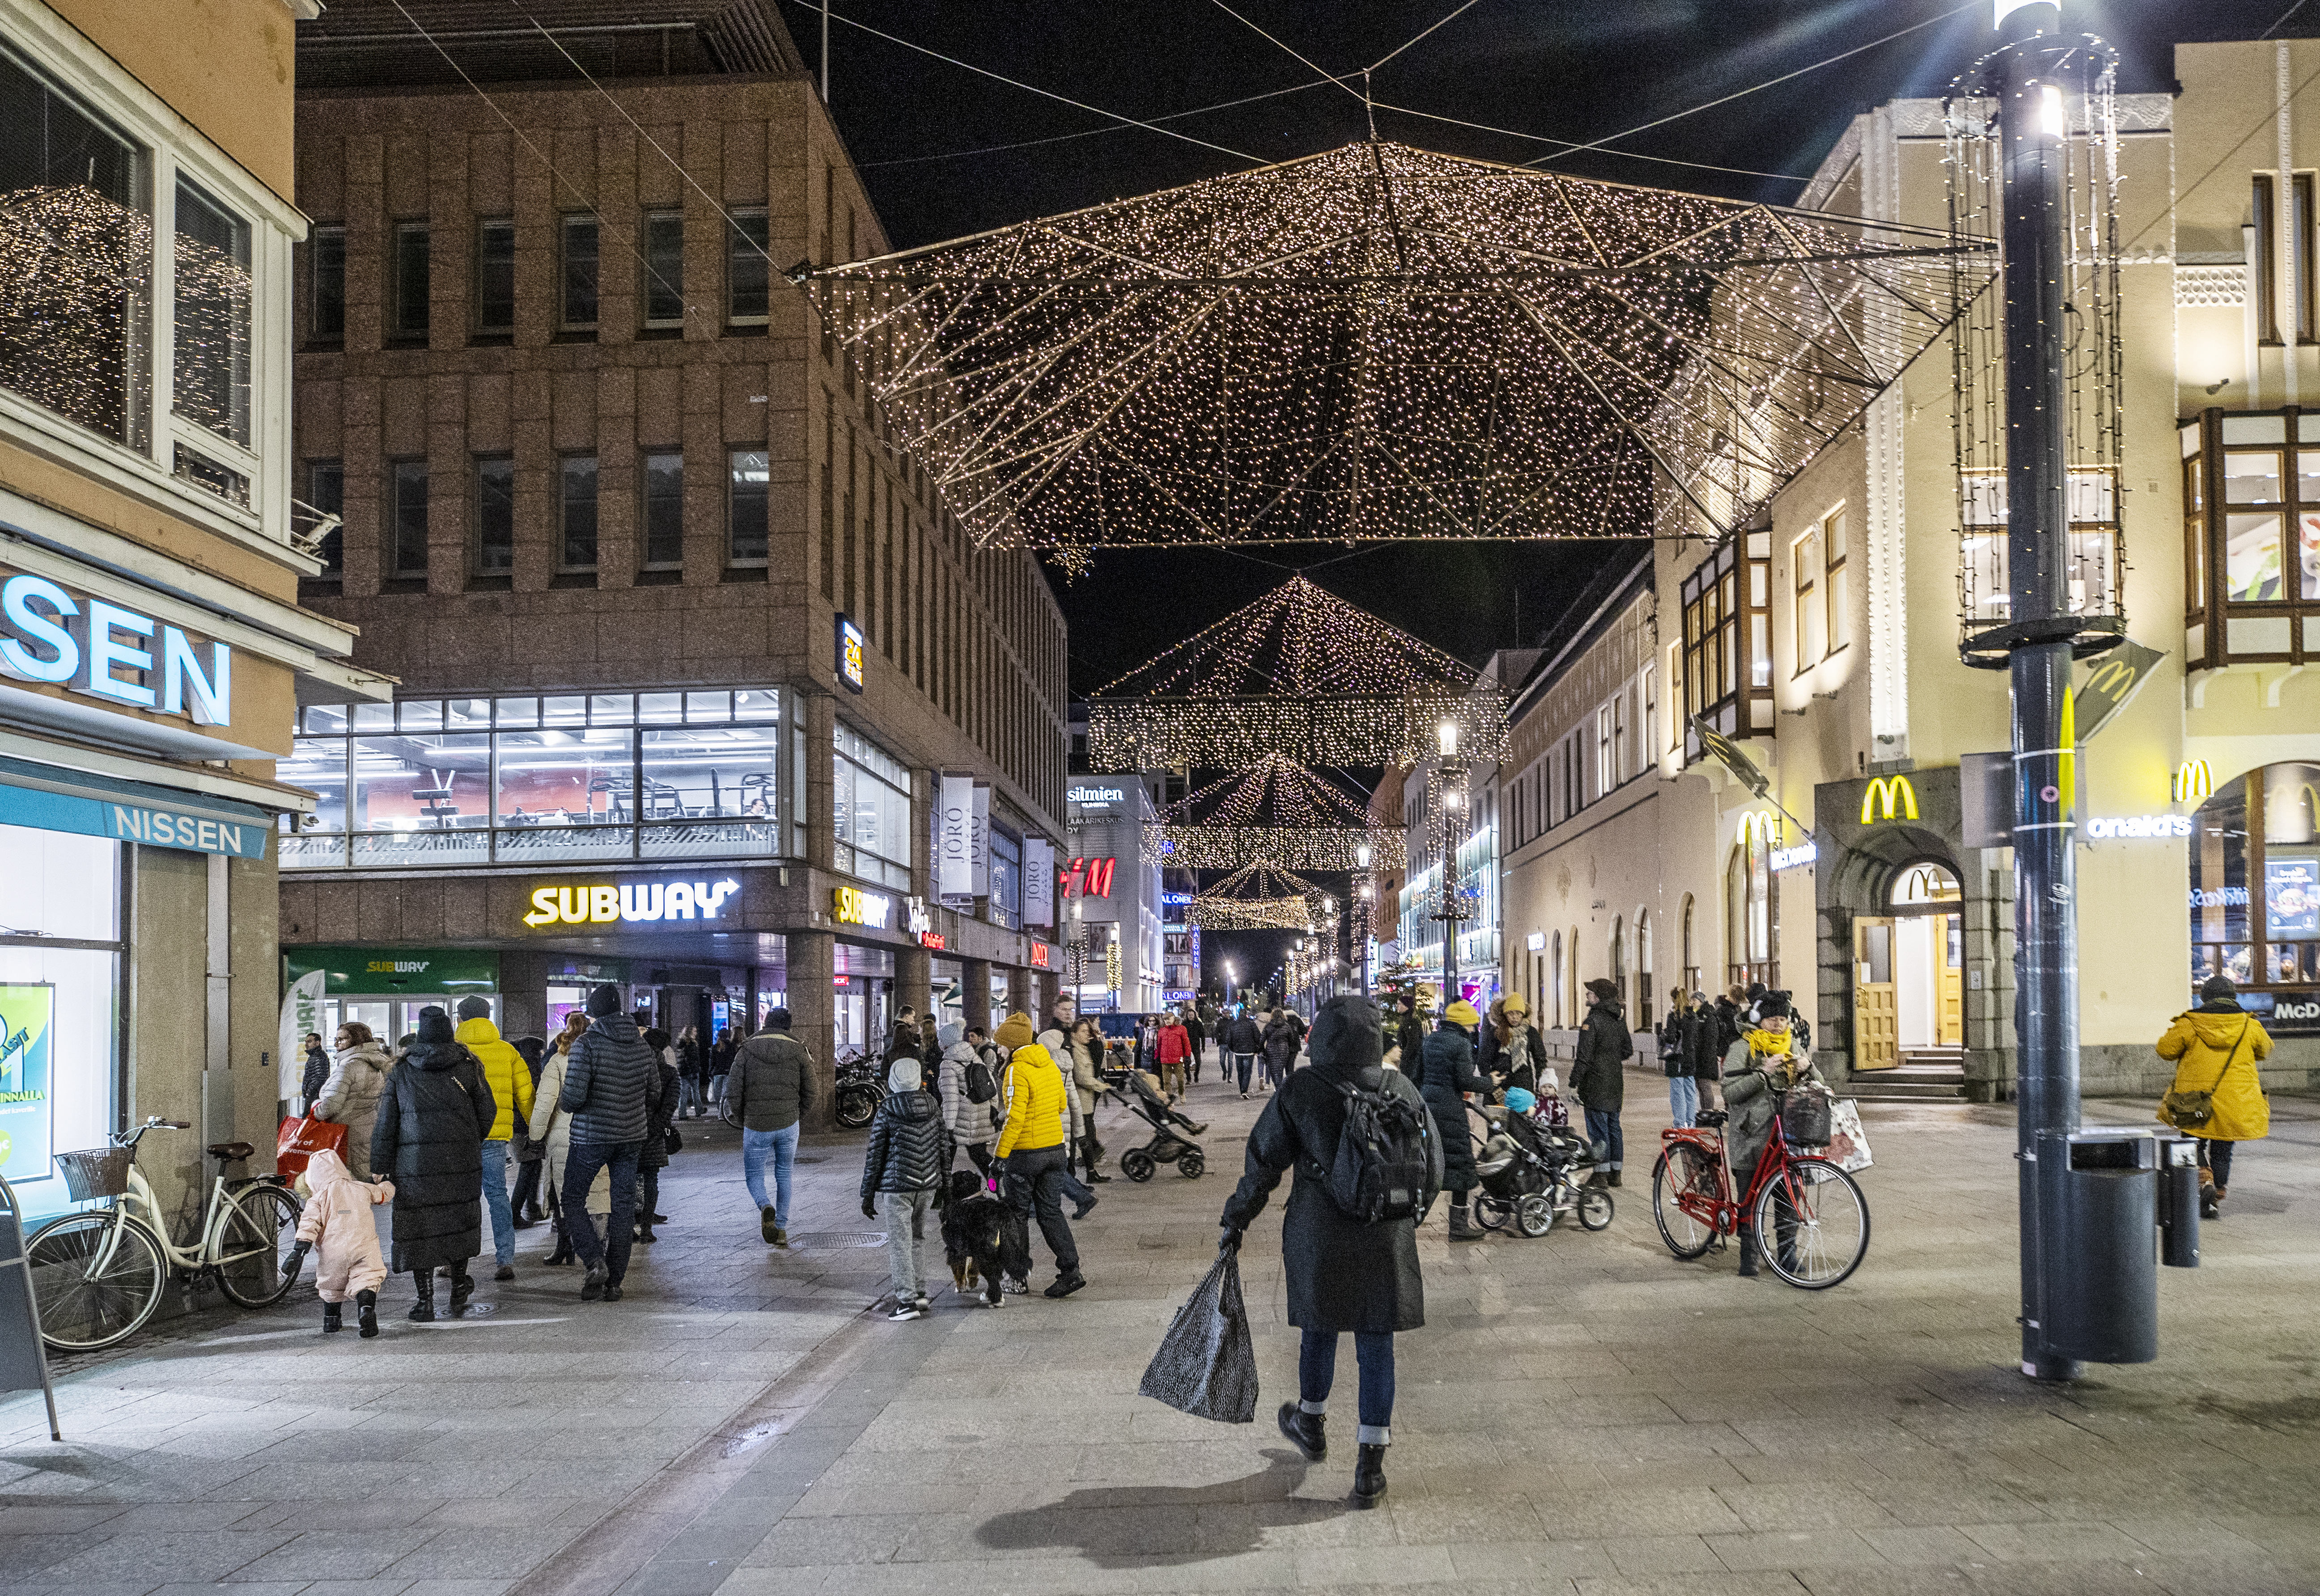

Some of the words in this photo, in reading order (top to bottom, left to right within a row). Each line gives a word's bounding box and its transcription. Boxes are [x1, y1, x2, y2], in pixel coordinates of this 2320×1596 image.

[1067, 786, 1124, 802] silmien
[114, 806, 241, 853] NISSEN
[522, 877, 740, 928] SUBWAY
[366, 961, 429, 972] SUBWAY
[2274, 1002, 2320, 1019] McD
